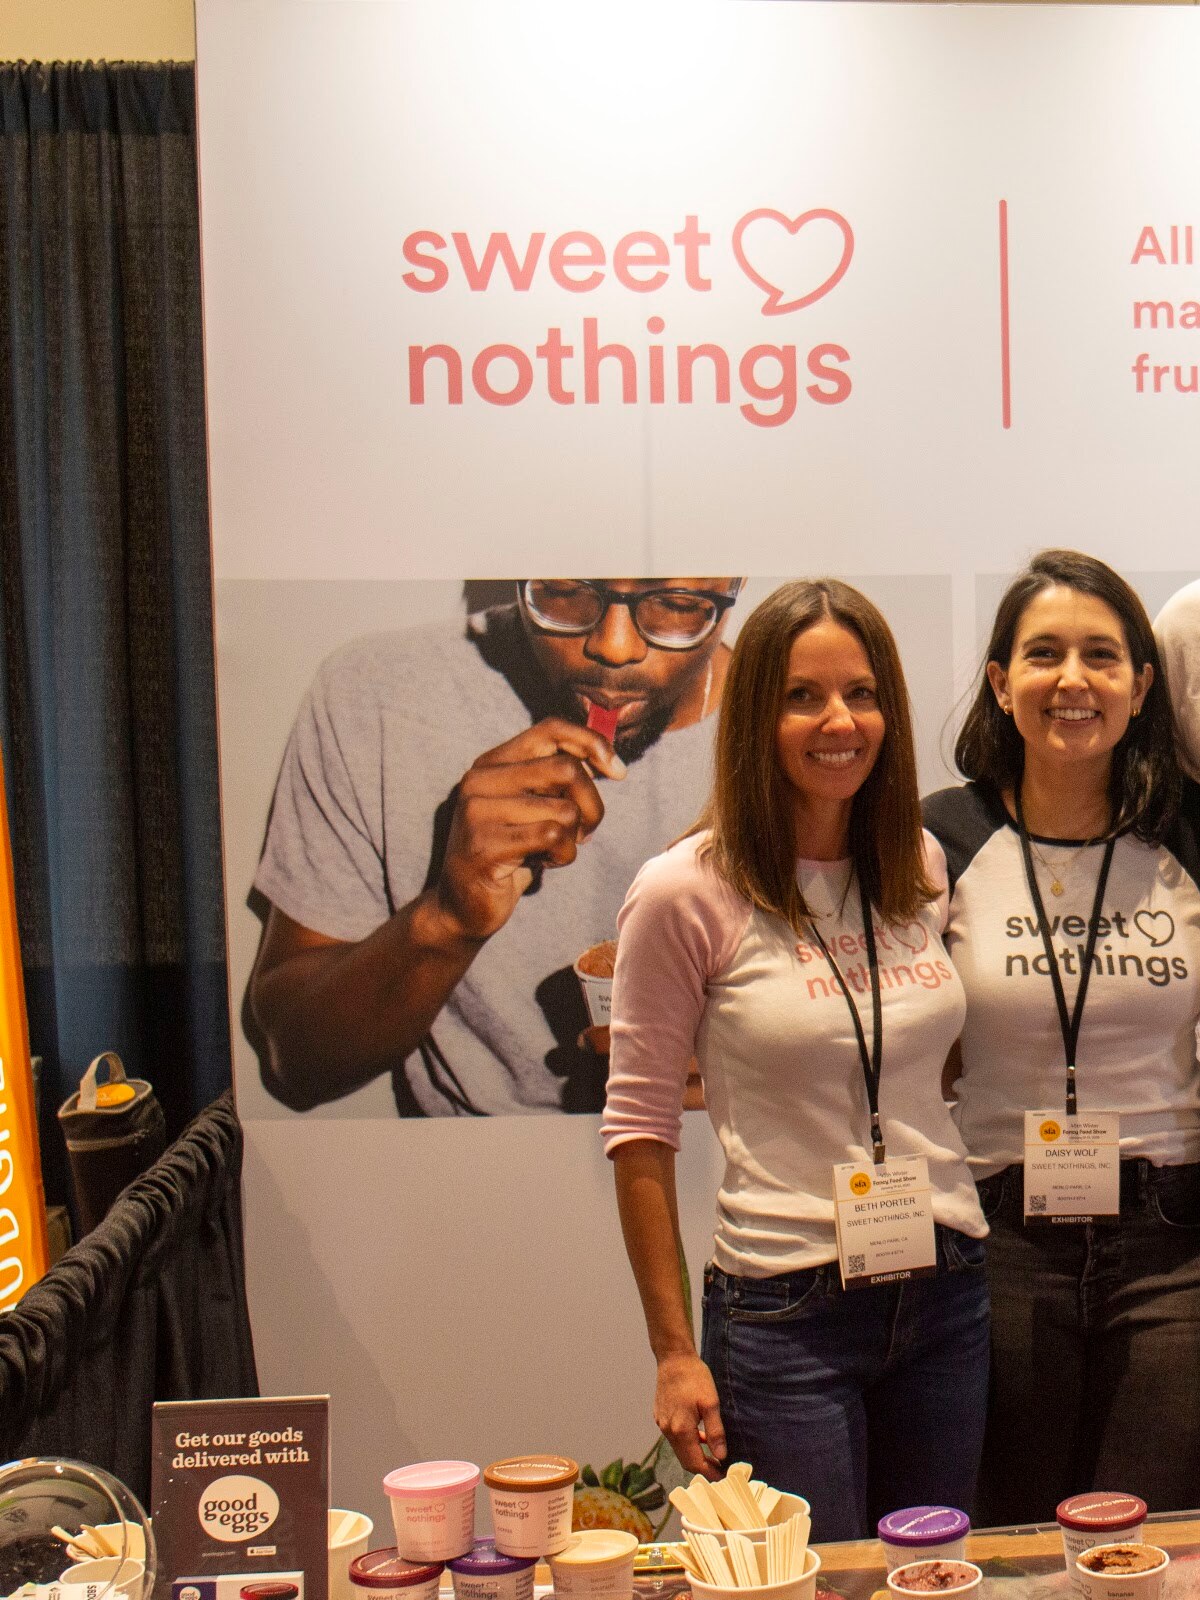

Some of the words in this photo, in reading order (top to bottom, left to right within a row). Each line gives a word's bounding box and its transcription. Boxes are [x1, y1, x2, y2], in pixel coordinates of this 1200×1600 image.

[402, 215, 712, 294] sweet
[1131, 226, 1194, 266] All
[408, 316, 852, 428] nothings
[1005, 911, 1129, 938] sweet
[1005, 944, 1188, 986] nothings
[1045, 1149, 1072, 1158] DAISY
[1074, 1149, 1099, 1157] WOLF
[855, 1202, 878, 1213] BETH
[880, 1197, 916, 1209] PORTER
[847, 1217, 872, 1228] SWEET
[1052, 1216, 1093, 1224] EXHIBITOR
[871, 1271, 911, 1284] EXHIBITOR
[175, 1432, 210, 1448] Get
[212, 1434, 247, 1446] our
[249, 1427, 303, 1447] goods
[172, 1449, 262, 1469] delivered
[265, 1447, 310, 1464] with
[204, 1493, 258, 1521] good
[495, 1499, 517, 1508] sweet
[220, 1512, 270, 1533] eggs
[496, 1509, 529, 1520] nothings
[460, 1582, 485, 1590] sweet
[461, 1589, 498, 1600] nothings
